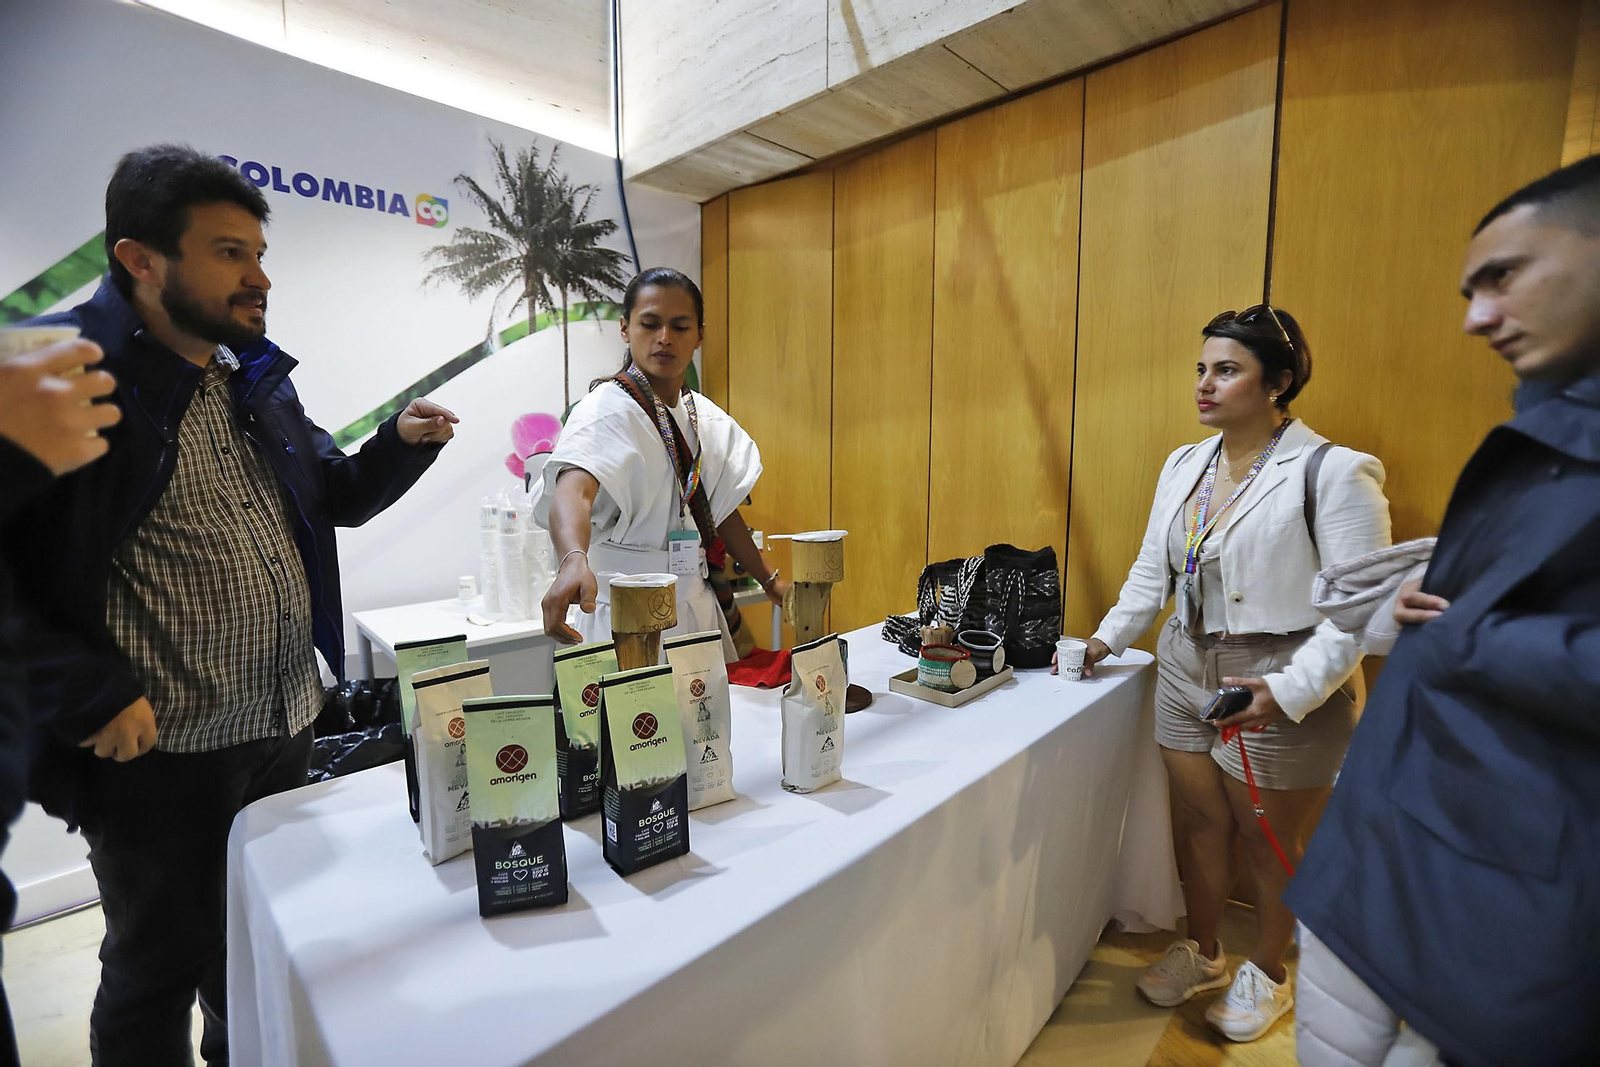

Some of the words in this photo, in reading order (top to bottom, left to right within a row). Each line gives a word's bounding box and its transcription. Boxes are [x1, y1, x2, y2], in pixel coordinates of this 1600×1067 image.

[630, 737, 667, 751] amorigen
[693, 733, 720, 745] NEVADA
[490, 772, 537, 786] amorigen
[638, 807, 675, 827] BOSQUE
[495, 855, 544, 870] BOSQUE
